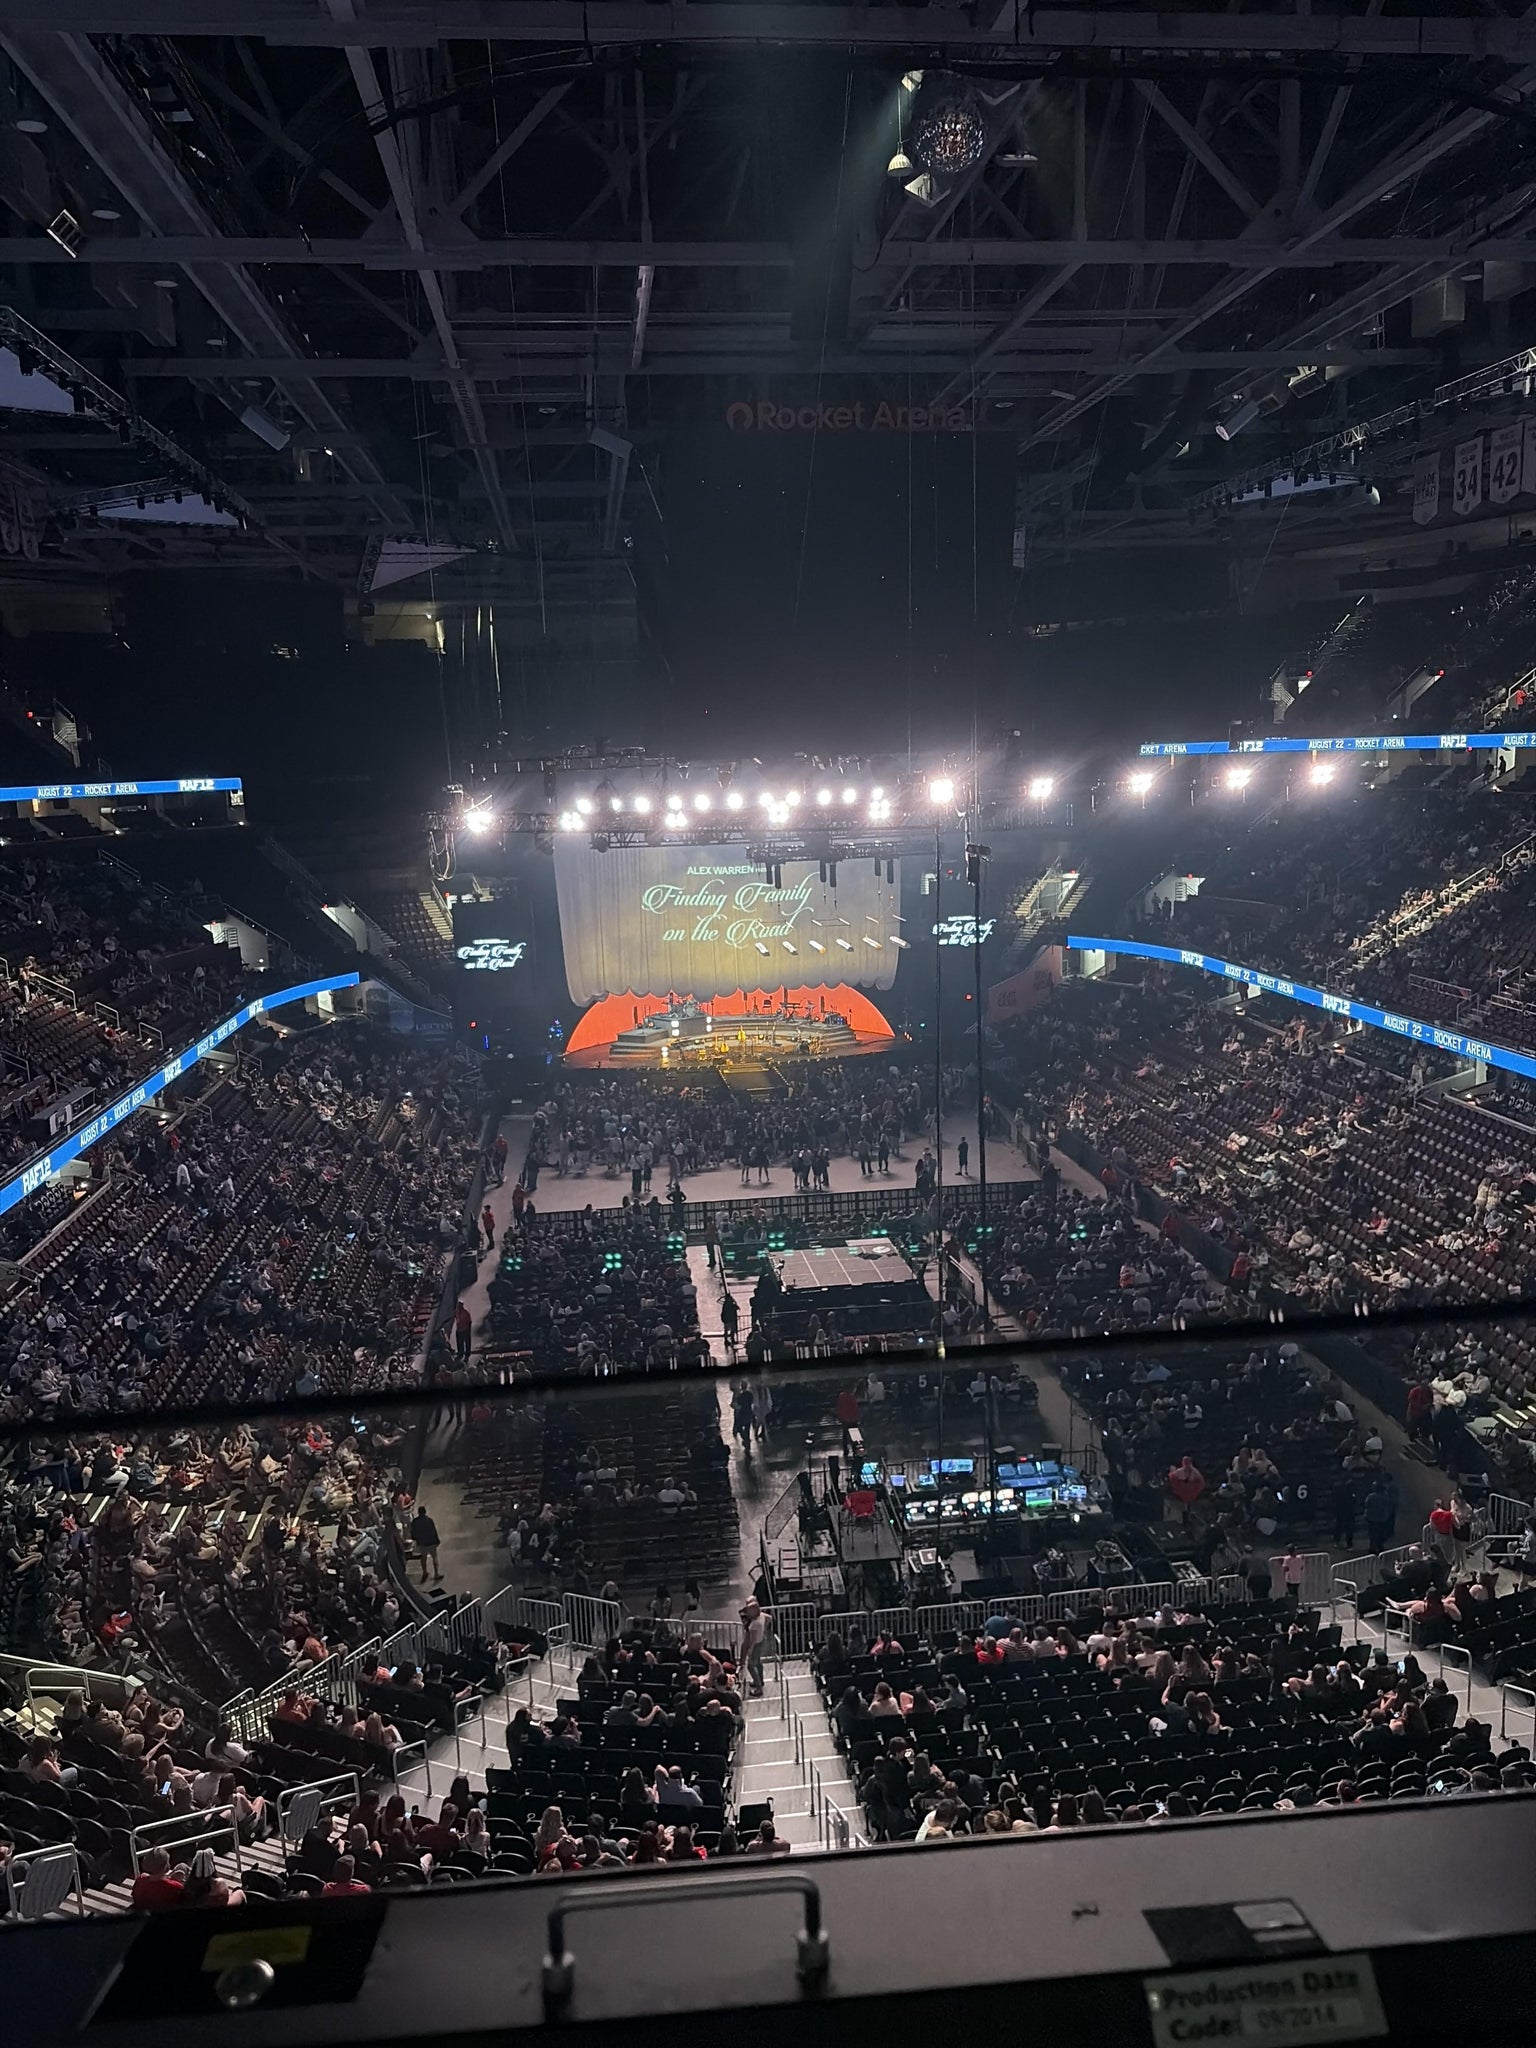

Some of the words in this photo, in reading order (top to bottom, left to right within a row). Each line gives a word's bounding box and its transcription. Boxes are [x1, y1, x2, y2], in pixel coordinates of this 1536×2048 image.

[757, 401, 866, 431] Rocket
[869, 401, 967, 431] Arena
[1492, 452, 1518, 489] 42
[1456, 465, 1478, 501] 34
[1163, 744, 1187, 753] ARENA
[1308, 740, 1333, 749] AUGUST
[1335, 739, 1345, 749] 22
[1355, 739, 1380, 748] ROCKET
[1383, 738, 1405, 748] ARENA
[1440, 735, 1467, 748] RAF12
[1504, 735, 1528, 746] AUGUST
[37, 787, 60, 798] AUGUST
[63, 787, 73, 796] 22
[84, 784, 112, 795] ROCKET
[115, 784, 138, 794] ARENA
[179, 779, 215, 791] RAF12
[687, 867, 712, 875] ALEX
[713, 865, 754, 875] WARREN
[641, 879, 728, 917] Finding
[733, 872, 820, 915] Family
[663, 927, 685, 941] on
[691, 915, 720, 941] the
[725, 911, 804, 948] Road
[1322, 995, 1350, 1015] RAF12
[1383, 1015, 1409, 1032] AUGUST
[1412, 1024, 1422, 1037] 22
[1434, 1031, 1462, 1050] ROCKET
[1466, 1042, 1492, 1061] ARENA
[80, 1121, 99, 1147] AUGUST
[100, 1116, 109, 1132] 22
[113, 1098, 131, 1120] ROCKET
[132, 1088, 146, 1107] ARENA
[23, 1158, 52, 1194] RAF12
[1002, 1283, 1011, 1296] 3
[918, 1374, 928, 1388] 5
[1297, 1483, 1308, 1500] 6
[528, 1532, 540, 1549] 4
[1162, 1979, 1296, 2010] Production
[1302, 1970, 1360, 1993] Date
